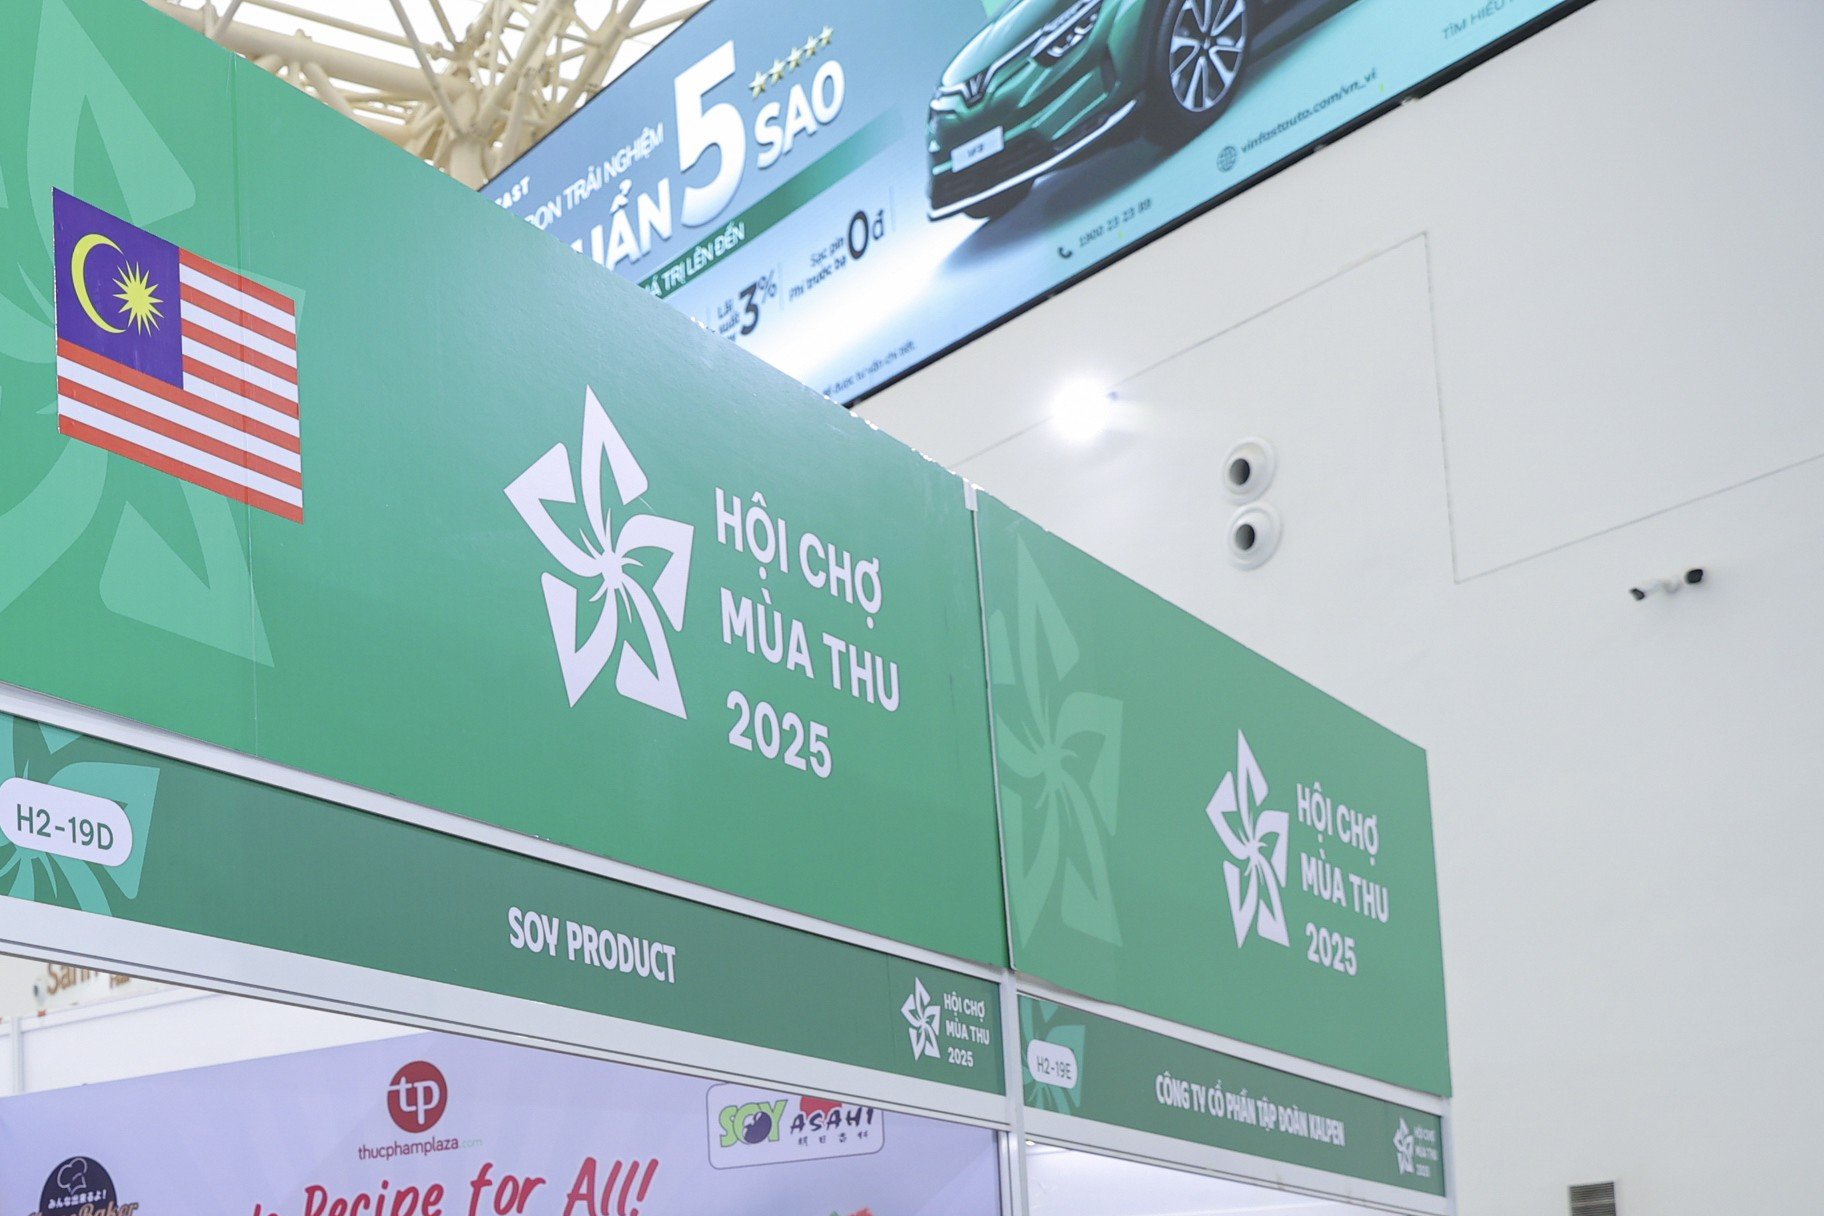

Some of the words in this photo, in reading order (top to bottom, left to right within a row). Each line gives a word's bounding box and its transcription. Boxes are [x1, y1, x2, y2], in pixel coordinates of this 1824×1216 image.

[674, 40, 747, 229] 5
[754, 59, 846, 170] SAO
[1240, 67, 1378, 154] vinfastauto.com/vn_vi
[563, 166, 602, 210] TRẢI
[604, 121, 665, 182] NGHIỆM
[685, 242, 714, 276] LÊN
[714, 221, 746, 258] ĐẾN
[738, 269, 778, 336] 3%
[715, 486, 789, 580] HỘI
[798, 532, 882, 629] CHỢ
[720, 586, 813, 680] MÙA
[821, 638, 901, 714] THU
[725, 690, 833, 780] 2025
[15, 803, 115, 852] H2-19D
[1296, 781, 1333, 843] HỘI
[1336, 803, 1380, 866] CHỢ
[1300, 847, 1347, 908] MÙA
[1349, 871, 1390, 924] THU
[507, 904, 560, 958] SOY
[568, 919, 677, 984] PRODUCT
[1305, 922, 1357, 977] 2025
[943, 990, 963, 1009] HỘI
[964, 997, 986, 1022] CHỢ
[945, 1015, 969, 1041] MÙA
[970, 1025, 991, 1046] THU
[947, 1047, 975, 1068] 2025
[1036, 1056, 1073, 1081] H2-19E
[387, 1073, 440, 1124] tp
[718, 1099, 789, 1148] SOY
[789, 1107, 875, 1135] ASAHI
[1155, 1071, 1189, 1110] CÔNG
[1190, 1083, 1206, 1114] TY
[1207, 1079, 1225, 1118] CỔ
[1225, 1087, 1256, 1126] PHẦN
[1256, 1095, 1277, 1132] TẬP
[357, 1133, 483, 1163] thucphamplaza.com
